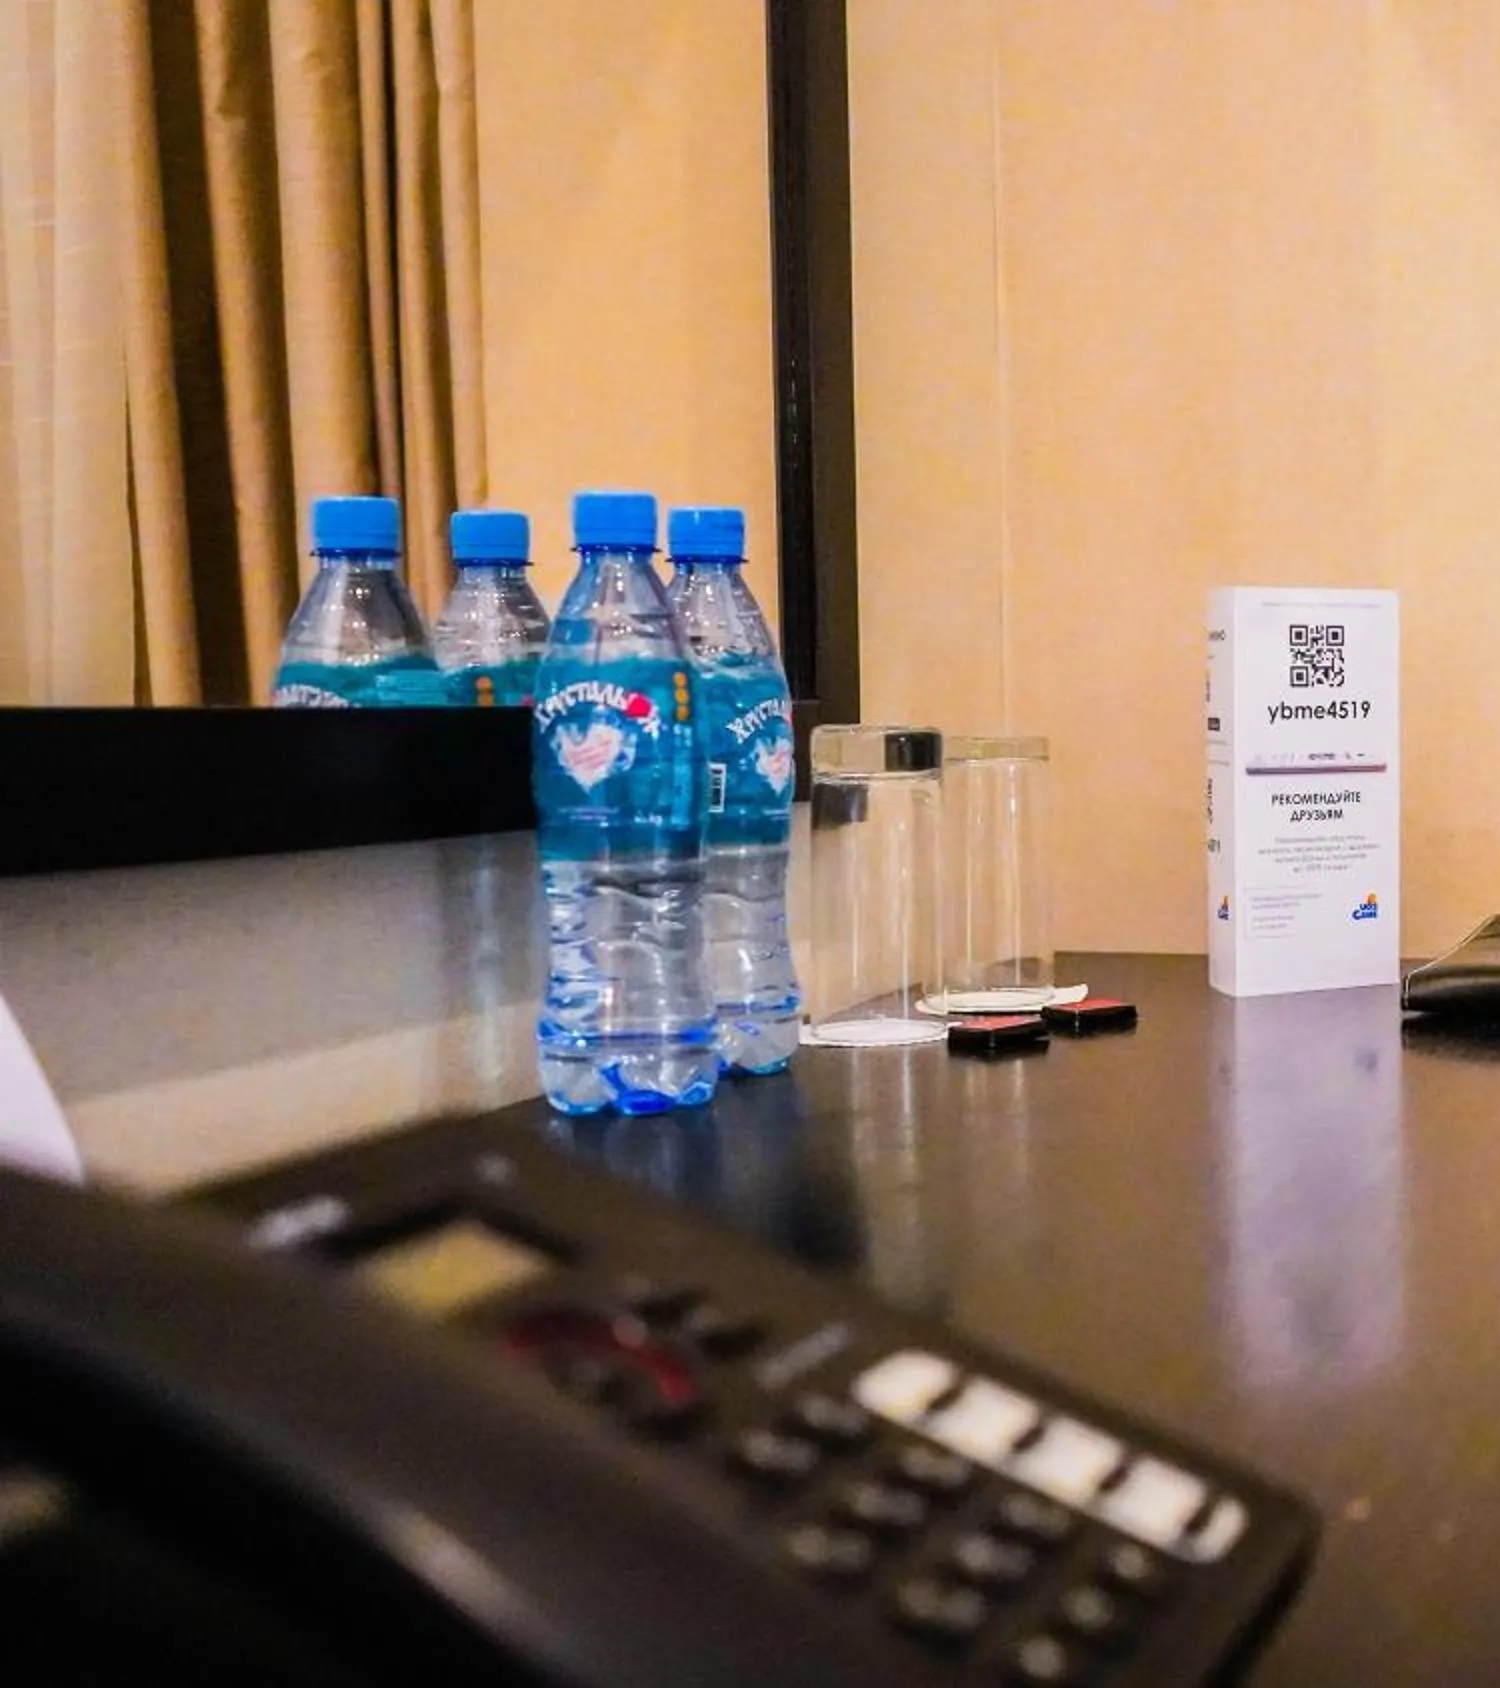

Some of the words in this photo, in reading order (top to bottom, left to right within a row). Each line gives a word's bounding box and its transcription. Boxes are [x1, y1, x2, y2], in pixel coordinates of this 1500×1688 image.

[1267, 700, 1371, 725] ybme4519
[1271, 789, 1361, 806] РЕКОМЕНДУЙТЕ
[1289, 808, 1344, 822] ДРУЗЬЯМ
